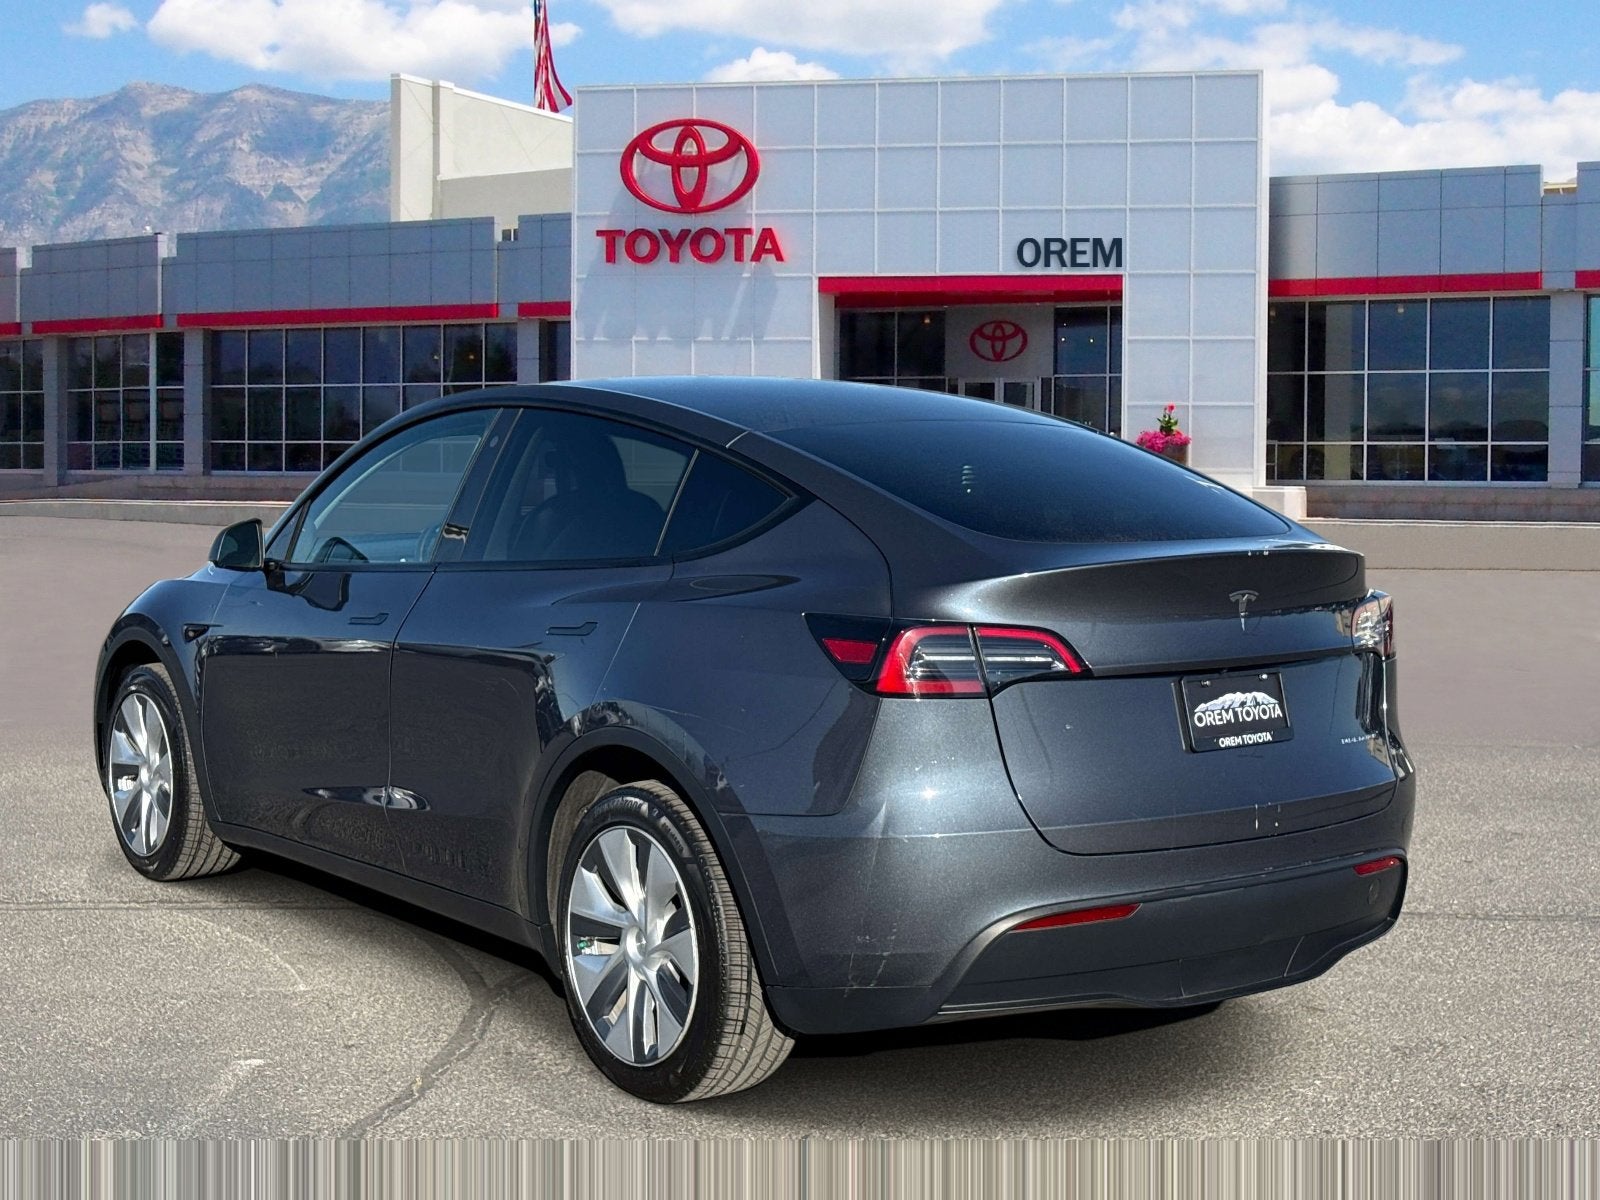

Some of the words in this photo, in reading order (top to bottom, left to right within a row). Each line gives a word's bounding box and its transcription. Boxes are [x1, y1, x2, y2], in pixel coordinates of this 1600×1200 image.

[596, 227, 785, 264] TOYOTA
[1017, 237, 1123, 268] OREM
[1194, 709, 1234, 727] OREM
[1236, 704, 1283, 722] TOYOTA
[1219, 736, 1242, 747] OREM
[1242, 732, 1272, 745] TOYOTA
